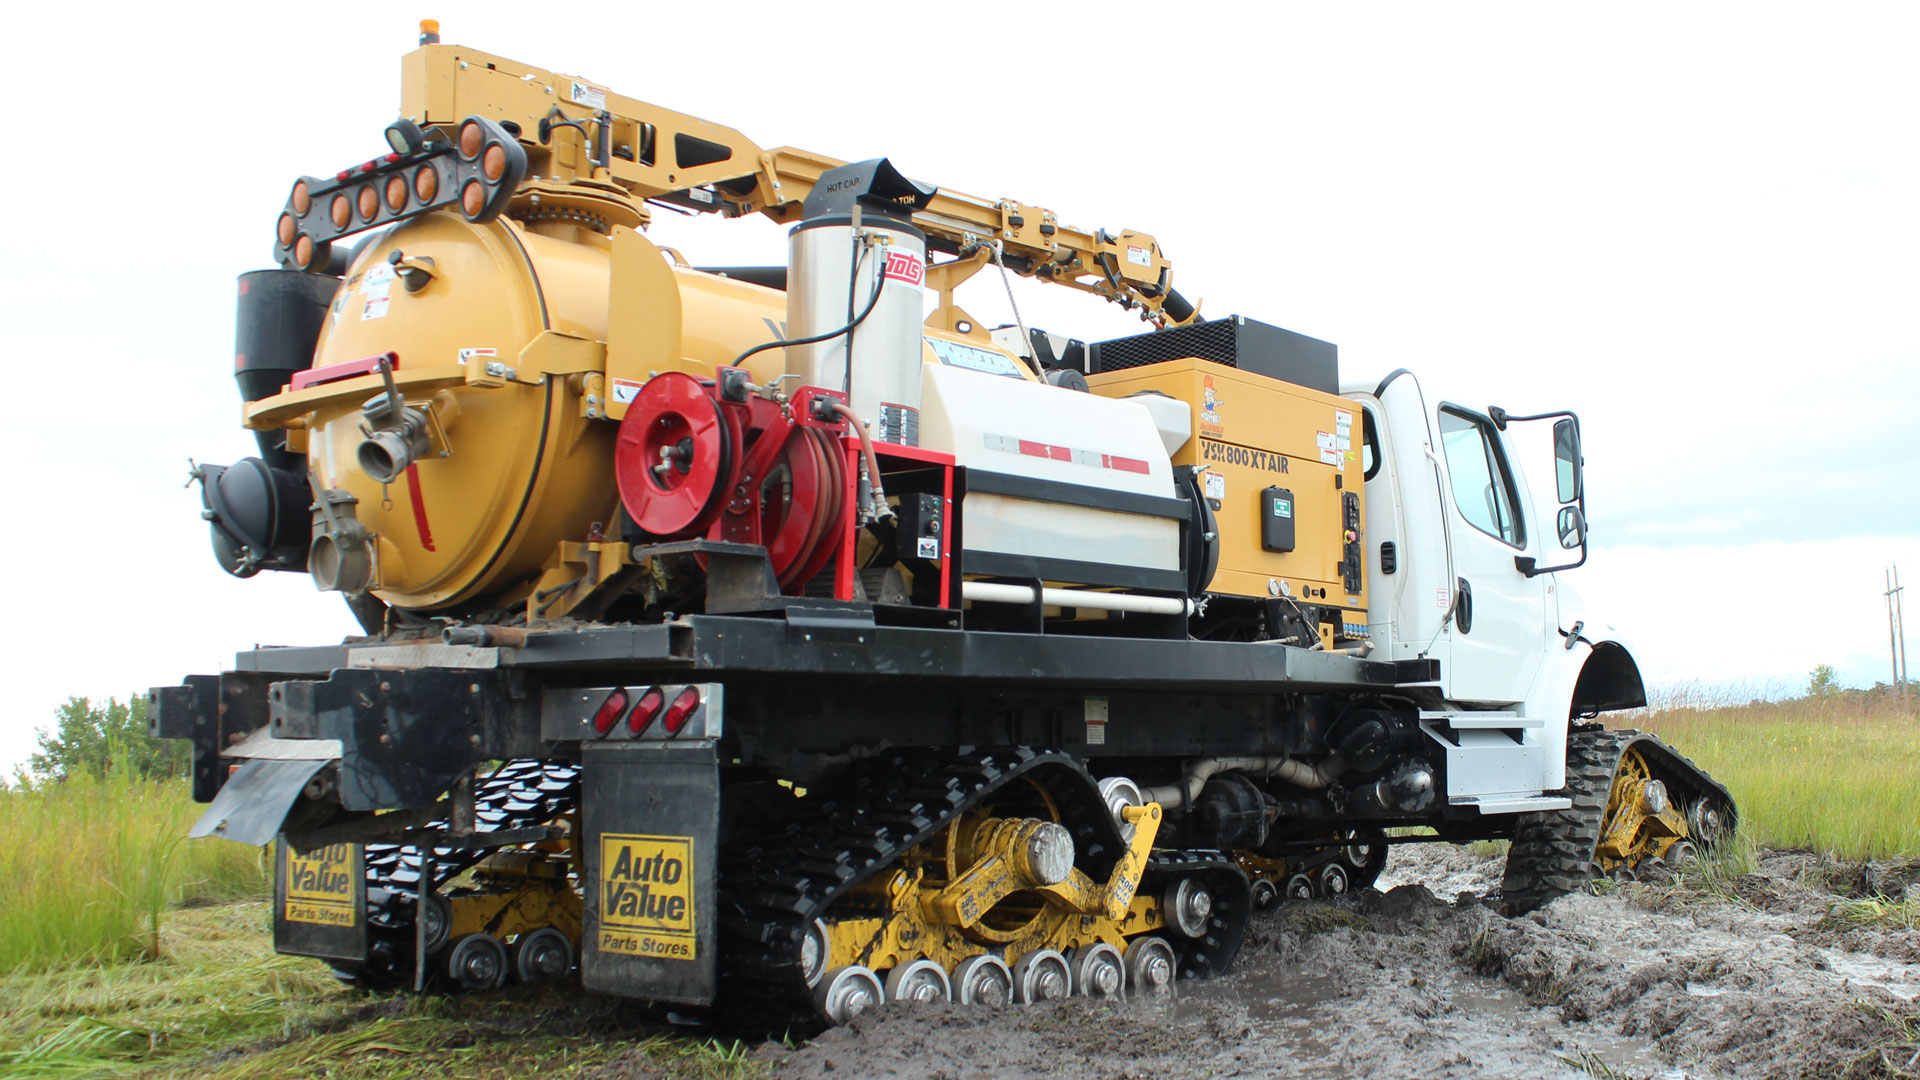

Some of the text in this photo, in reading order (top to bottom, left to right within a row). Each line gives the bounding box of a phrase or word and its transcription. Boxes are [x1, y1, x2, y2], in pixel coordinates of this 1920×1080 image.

[826, 177, 860, 194] HOT CAP
[291, 861, 349, 895] Value
[610, 845, 682, 885] Auto
[290, 905, 350, 923] Parts Stores
[605, 880, 686, 921] Value
[601, 933, 688, 956] Parts Stores
